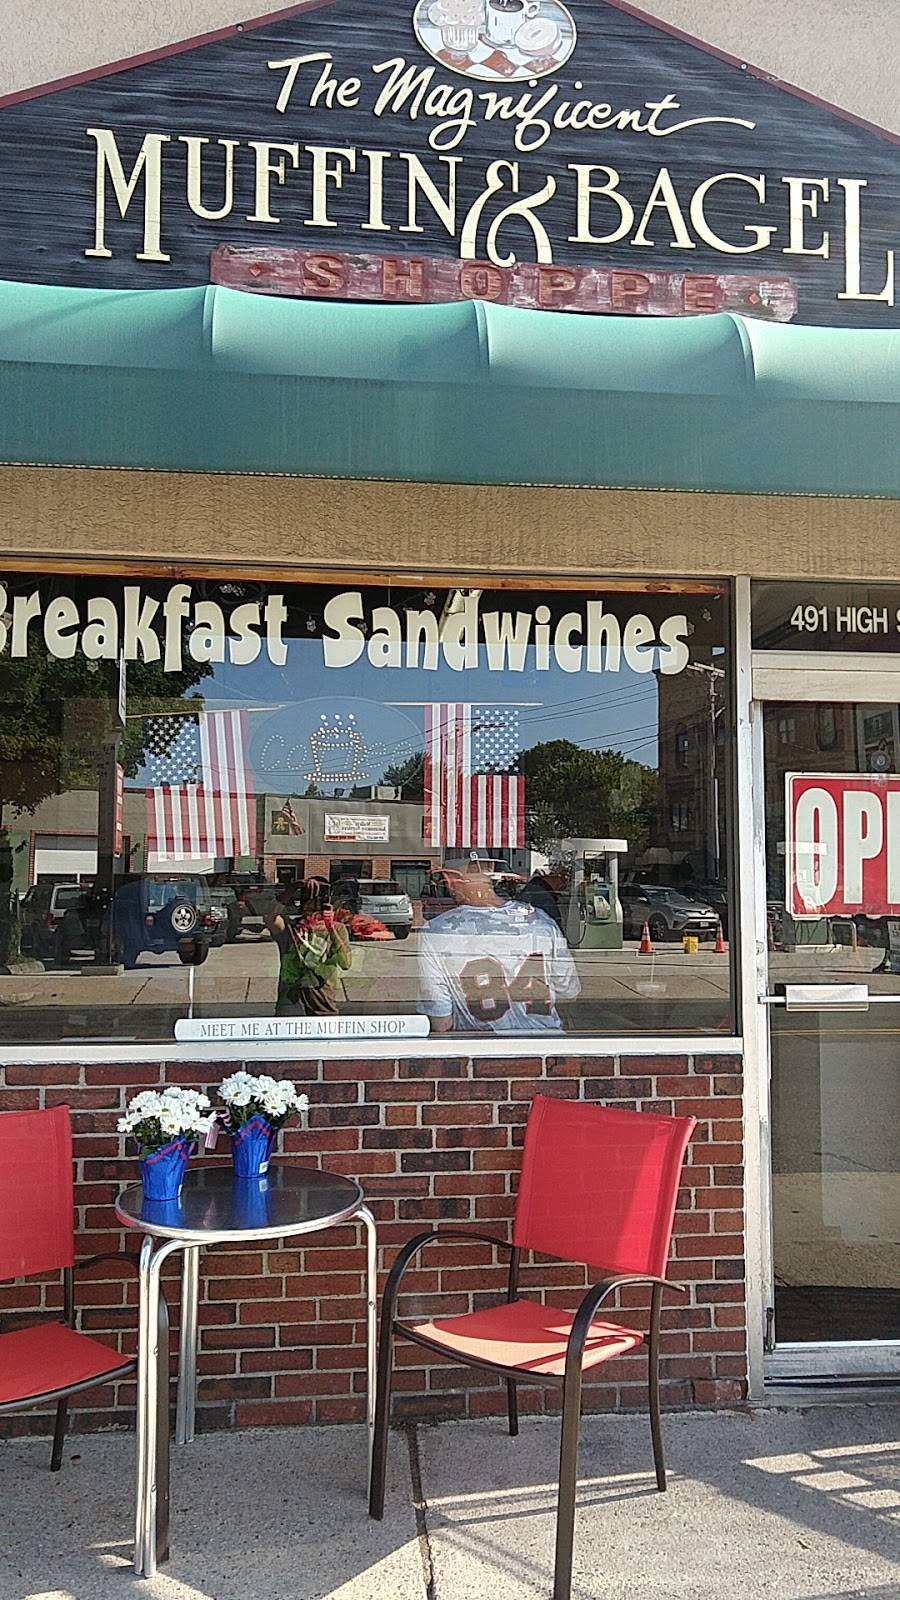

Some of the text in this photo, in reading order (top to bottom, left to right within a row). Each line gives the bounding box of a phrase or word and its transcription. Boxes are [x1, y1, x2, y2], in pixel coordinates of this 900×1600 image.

[267, 51, 757, 152] The Magnificent
[85, 127, 896, 306] MUFFIN & BAGEL
[302, 254, 720, 310] SHOPPE
[0, 584, 691, 675] reakfast Sandwiches
[789, 604, 829, 633] 491
[836, 606, 889, 634] HIGH
[457, 952, 554, 1024] 84
[200, 1020, 406, 1037] MEET ME AT THE MUFFIN SHOP
